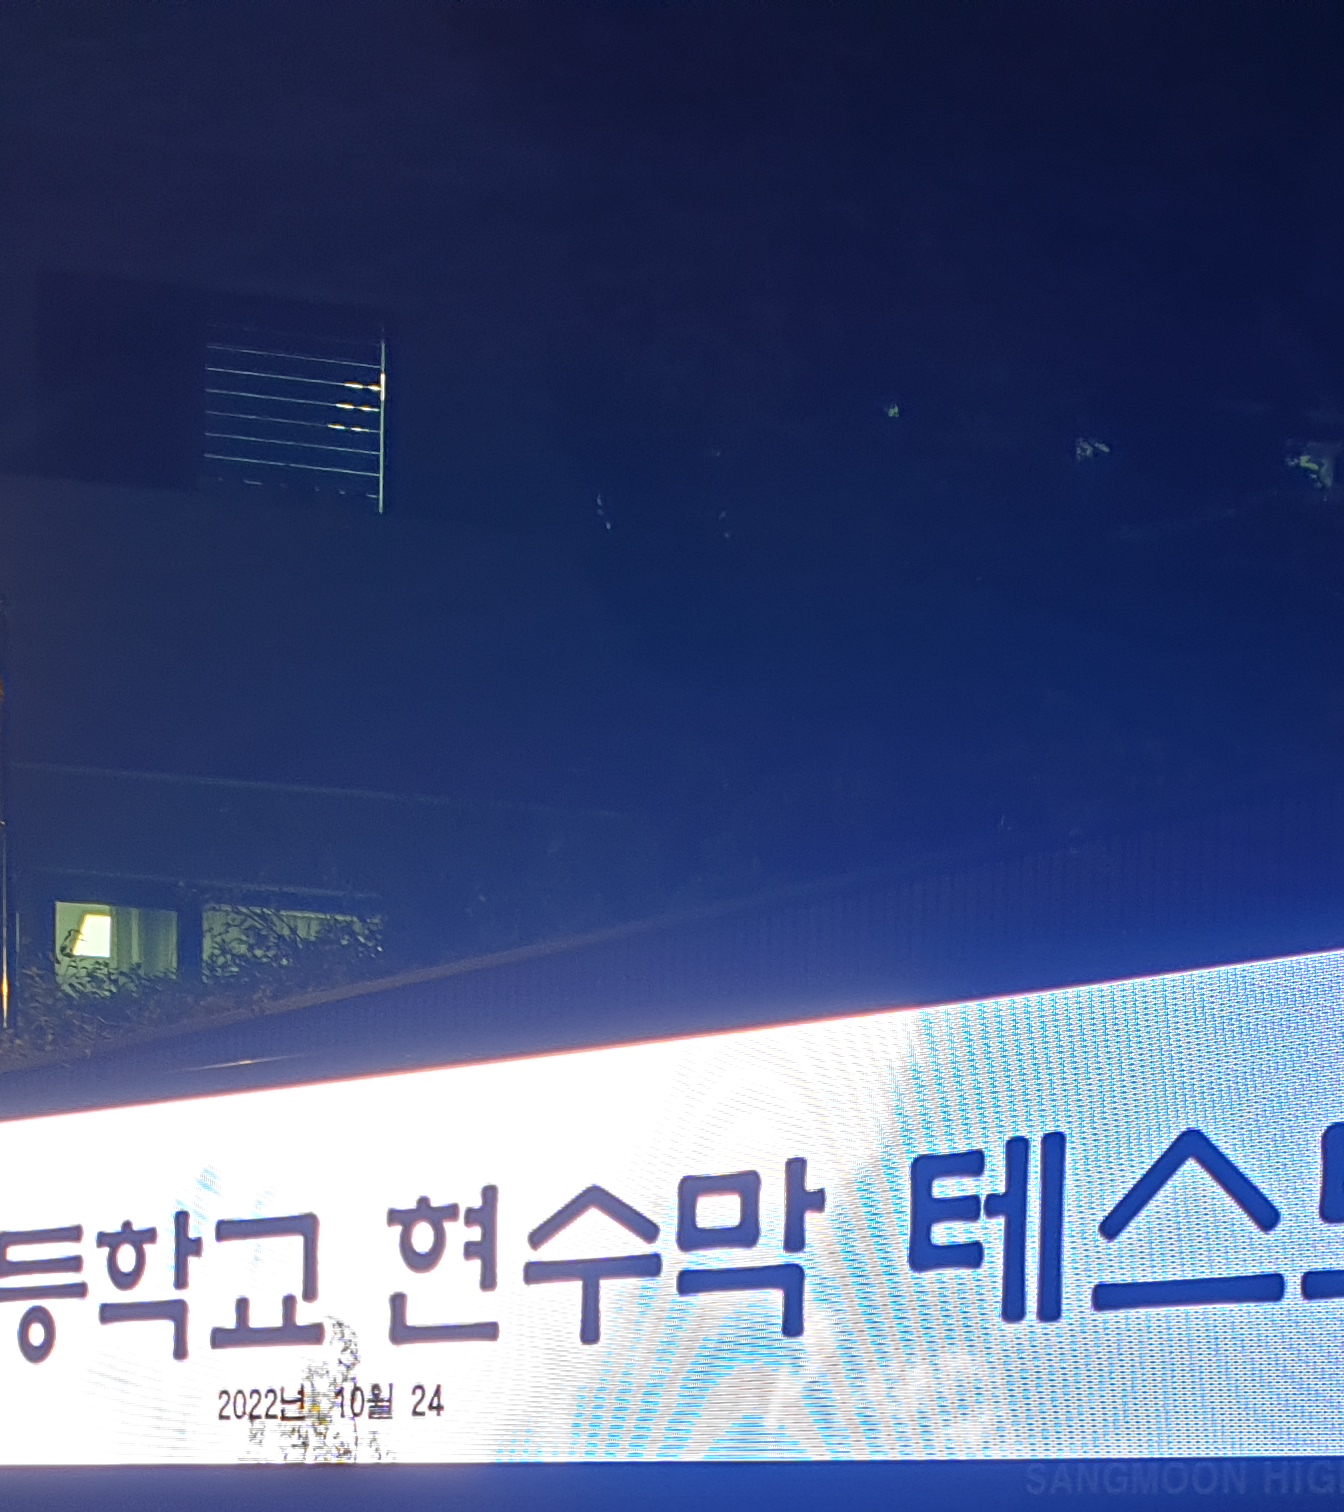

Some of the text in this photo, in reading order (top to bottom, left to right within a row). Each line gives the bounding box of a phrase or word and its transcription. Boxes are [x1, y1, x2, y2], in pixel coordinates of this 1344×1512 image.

[387, 1157, 825, 1345] 현수막
[218, 1383, 444, 1421] 2022년 10월 24
[1025, 1463, 1247, 1496] SANGMOON
